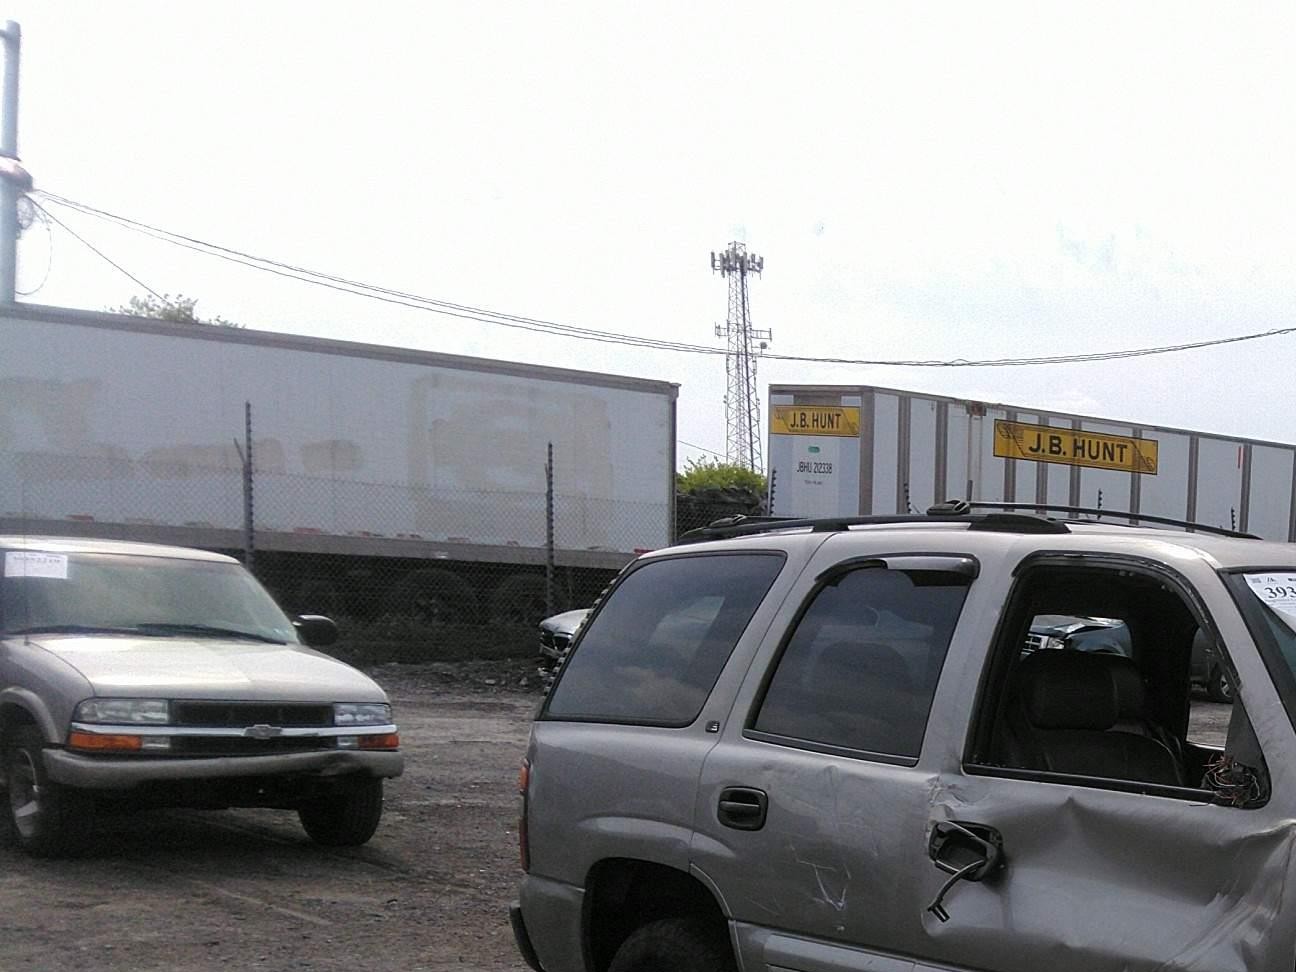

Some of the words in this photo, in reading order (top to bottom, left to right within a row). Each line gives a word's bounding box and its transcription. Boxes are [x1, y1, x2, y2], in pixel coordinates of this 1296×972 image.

[790, 412, 809, 428] J.B.
[812, 412, 841, 429] HUNT
[1029, 433, 1067, 456] J.B.
[1073, 437, 1128, 463] HUNT
